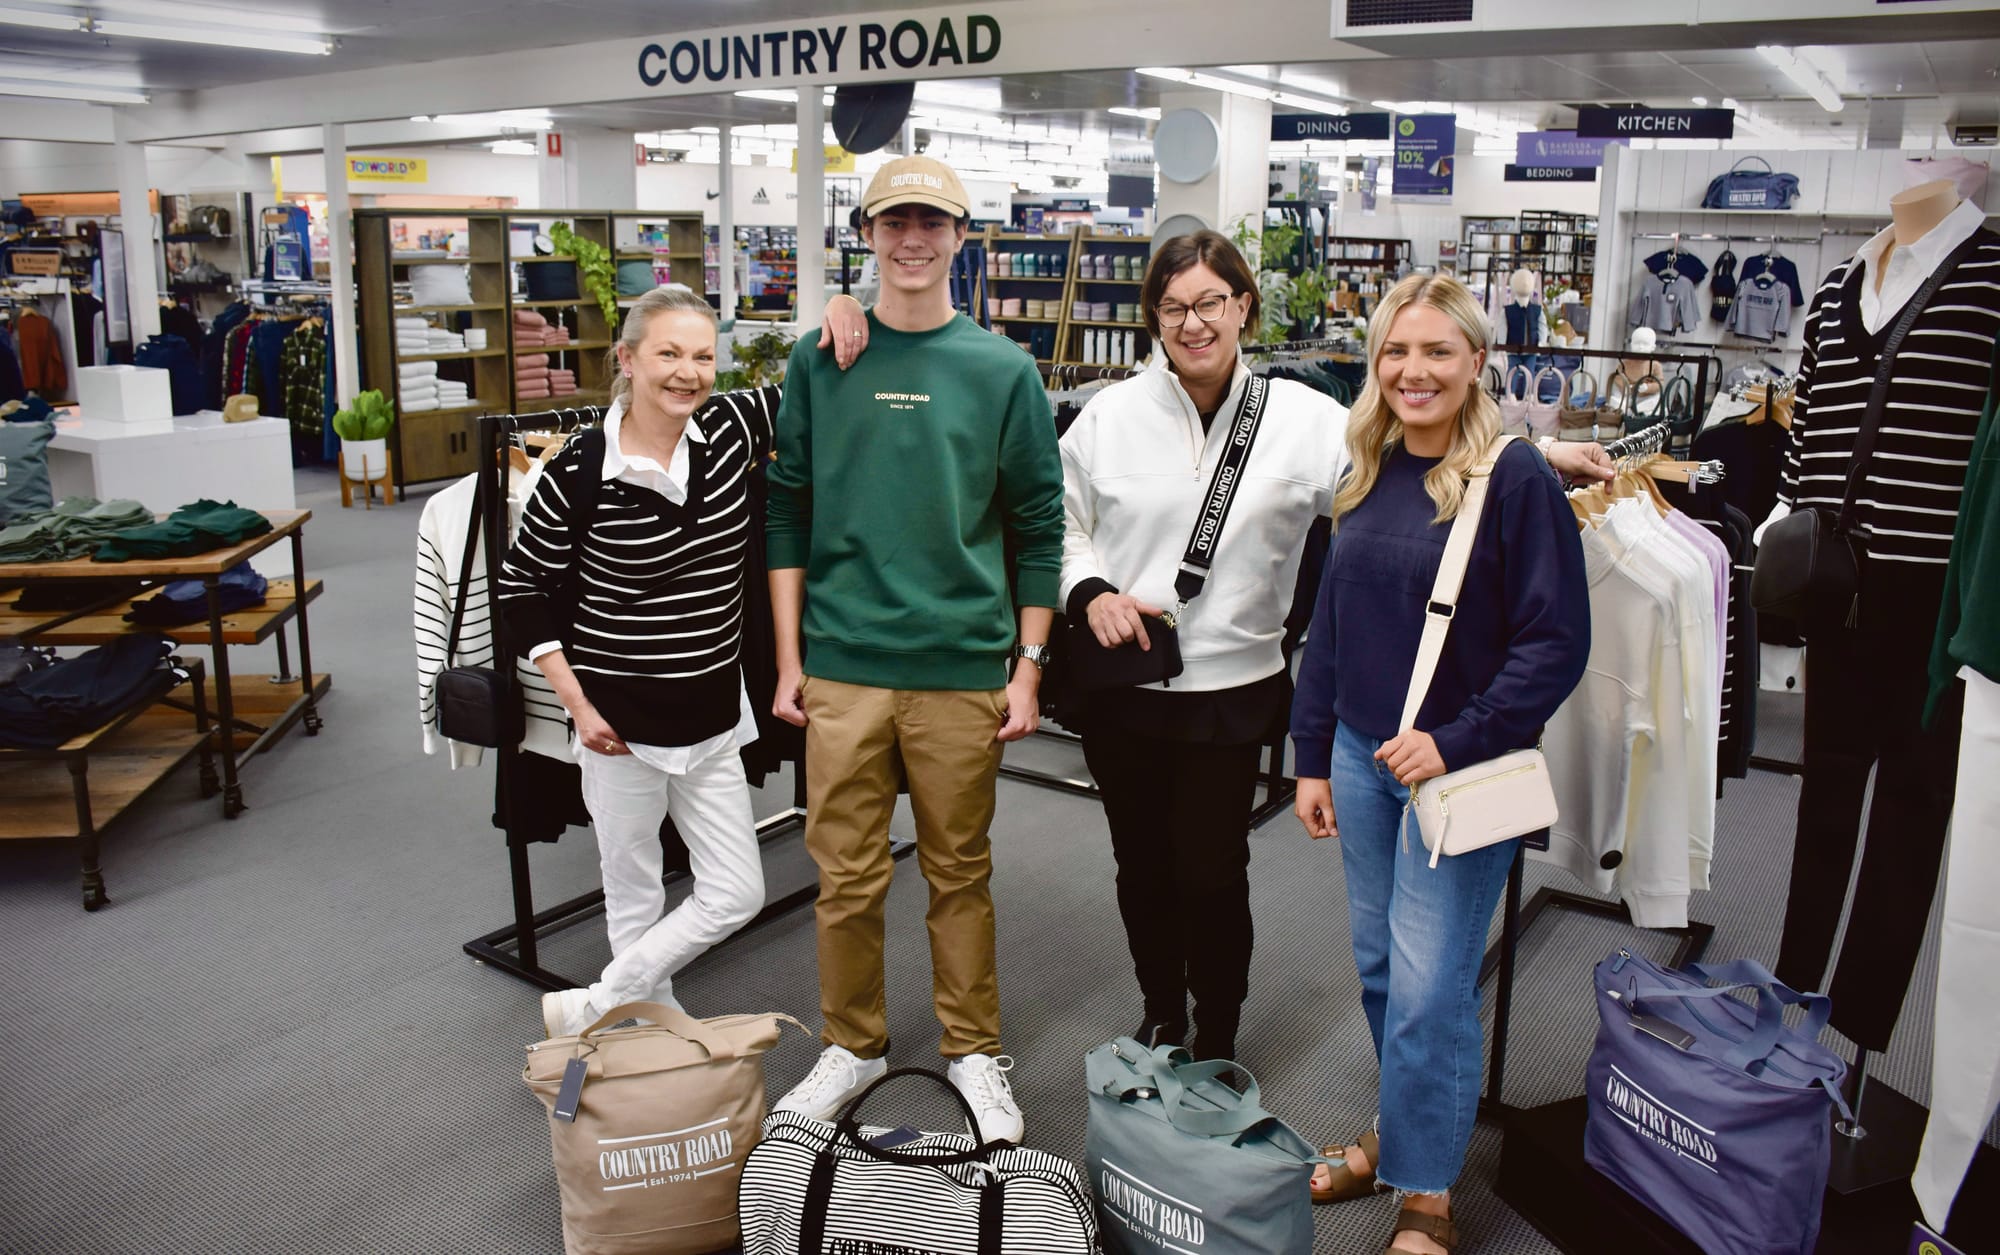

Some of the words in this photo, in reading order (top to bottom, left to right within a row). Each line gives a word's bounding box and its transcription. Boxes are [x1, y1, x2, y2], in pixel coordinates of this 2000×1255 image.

[638, 26, 847, 86] COUNTRY
[860, 15, 1001, 70] ROAD
[1297, 121, 1351, 134] DINING
[1617, 116, 1691, 131] KITCHEN
[350, 160, 408, 174] TOYWORLD
[1398, 150, 1424, 163] 10%
[891, 173, 923, 187] COUNTRY
[923, 173, 942, 190] ROAD
[1526, 168, 1574, 178] BEDDING
[875, 393, 909, 401] COUNTRY
[1245, 376, 1263, 418] COUNTRY
[1234, 416, 1254, 446] ROAD
[1210, 466, 1234, 515] COUNTRY
[1196, 517, 1215, 551] ROAD
[1607, 1076, 1668, 1136] COUNTRY
[1670, 1119, 1717, 1162] ROAD
[1641, 1128, 1655, 1141] Est.
[1657, 1136, 1676, 1152] 1974
[599, 1142, 681, 1180] COUNTRY
[684, 1129, 732, 1167] ROAD
[650, 1177, 667, 1186] Est.
[669, 1172, 691, 1183] 1974
[1102, 1170, 1158, 1228] COUNTRY
[1159, 1202, 1205, 1246] ROAD
[1130, 1222, 1143, 1235] Est.
[1144, 1229, 1161, 1245] 1974
